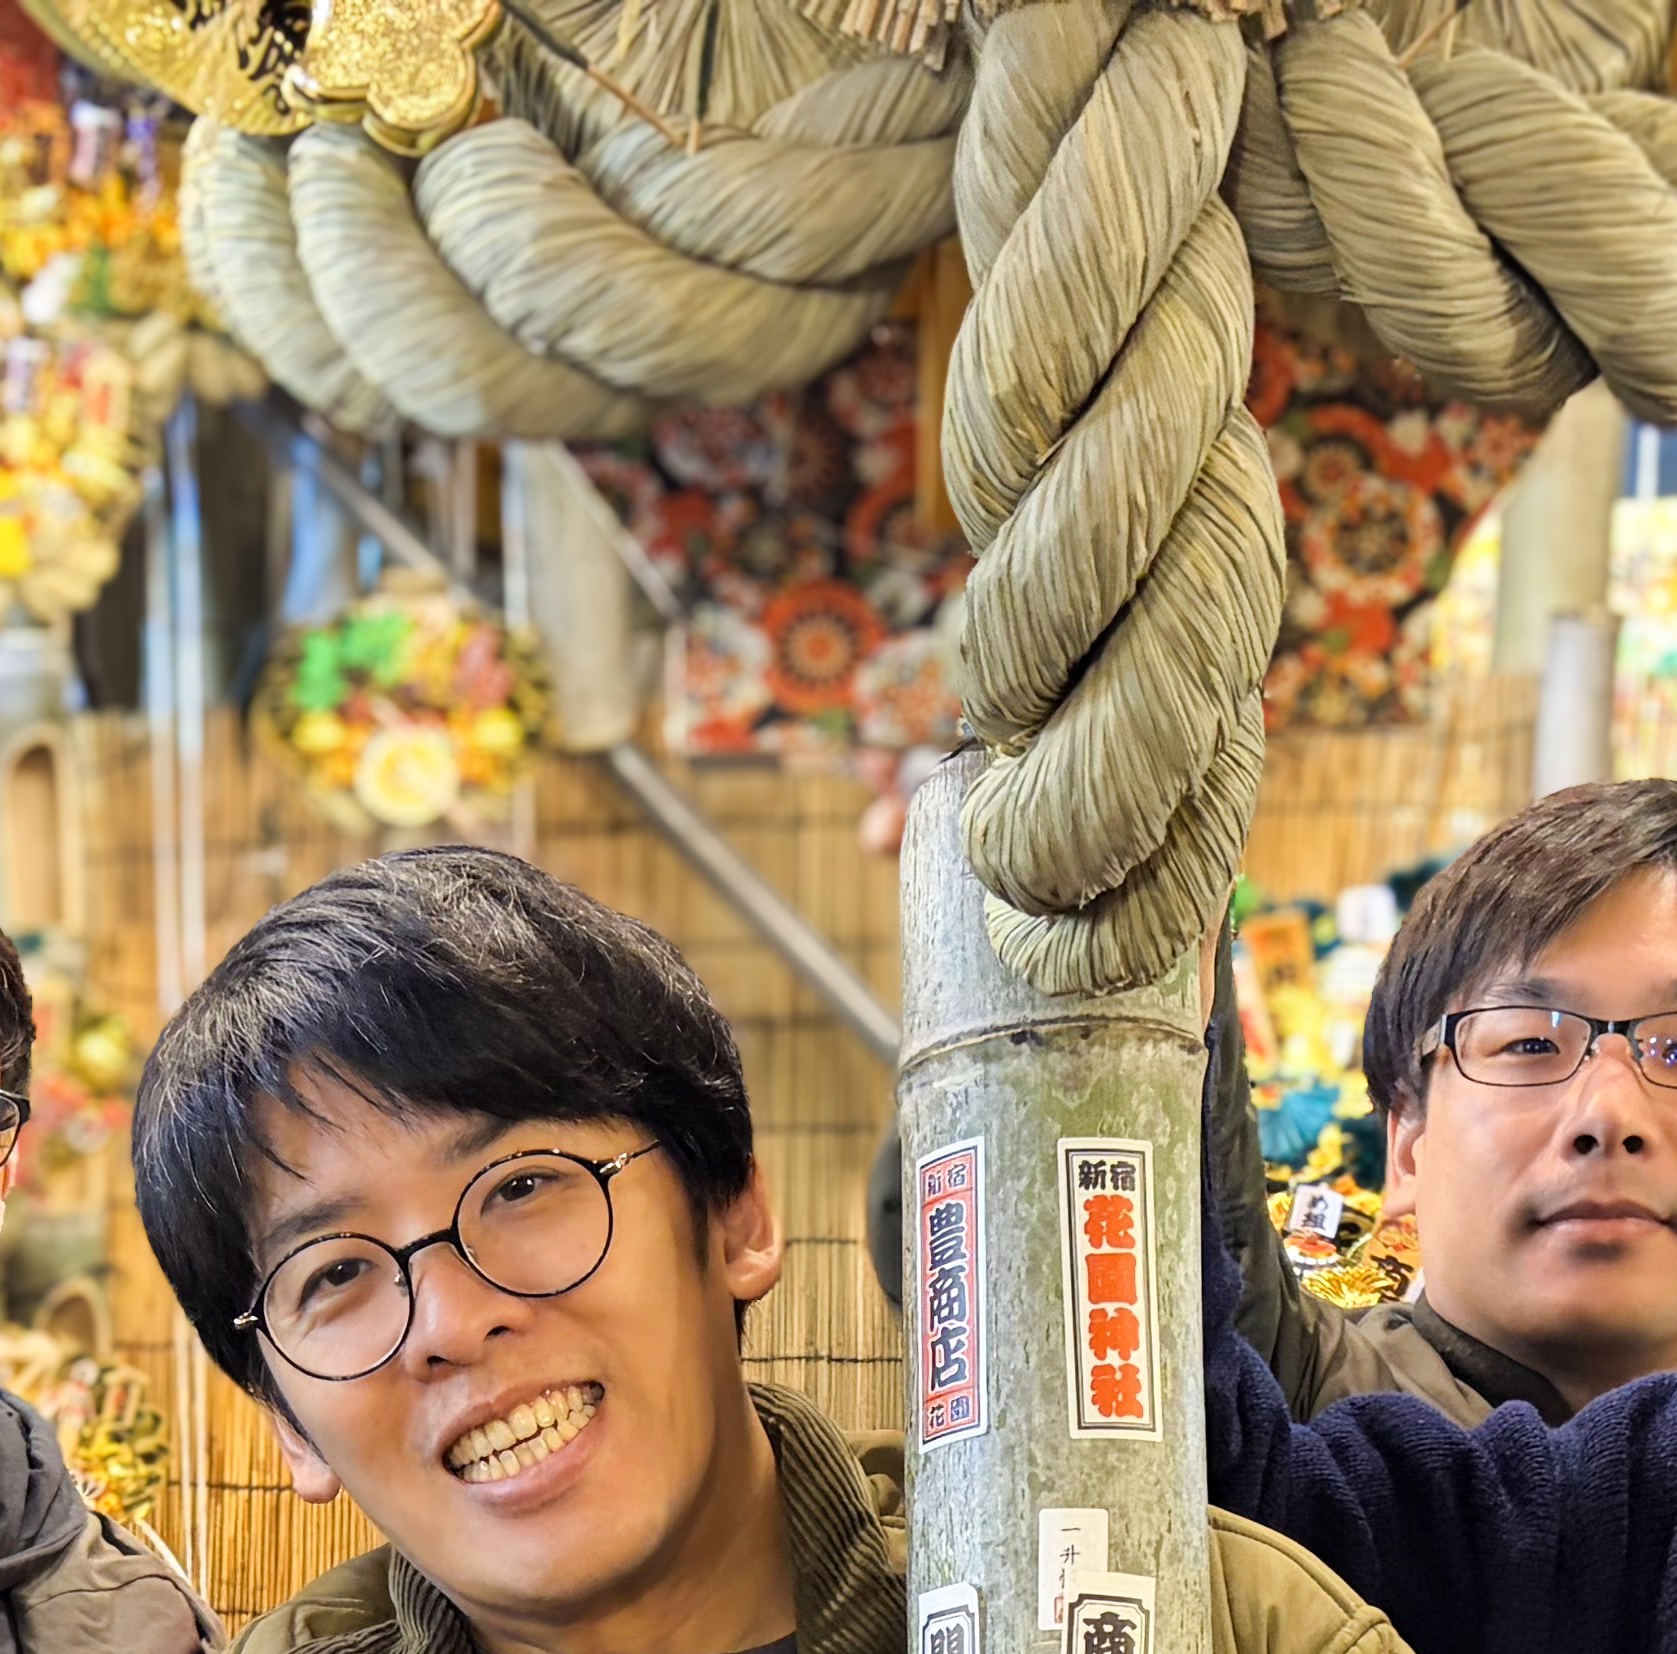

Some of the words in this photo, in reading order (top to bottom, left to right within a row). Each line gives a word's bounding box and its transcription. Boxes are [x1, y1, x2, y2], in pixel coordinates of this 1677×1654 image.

[1078, 1160, 1136, 1191] 新宿
[929, 1201, 968, 1391] 豊商店
[928, 1395, 970, 1429] 花園
